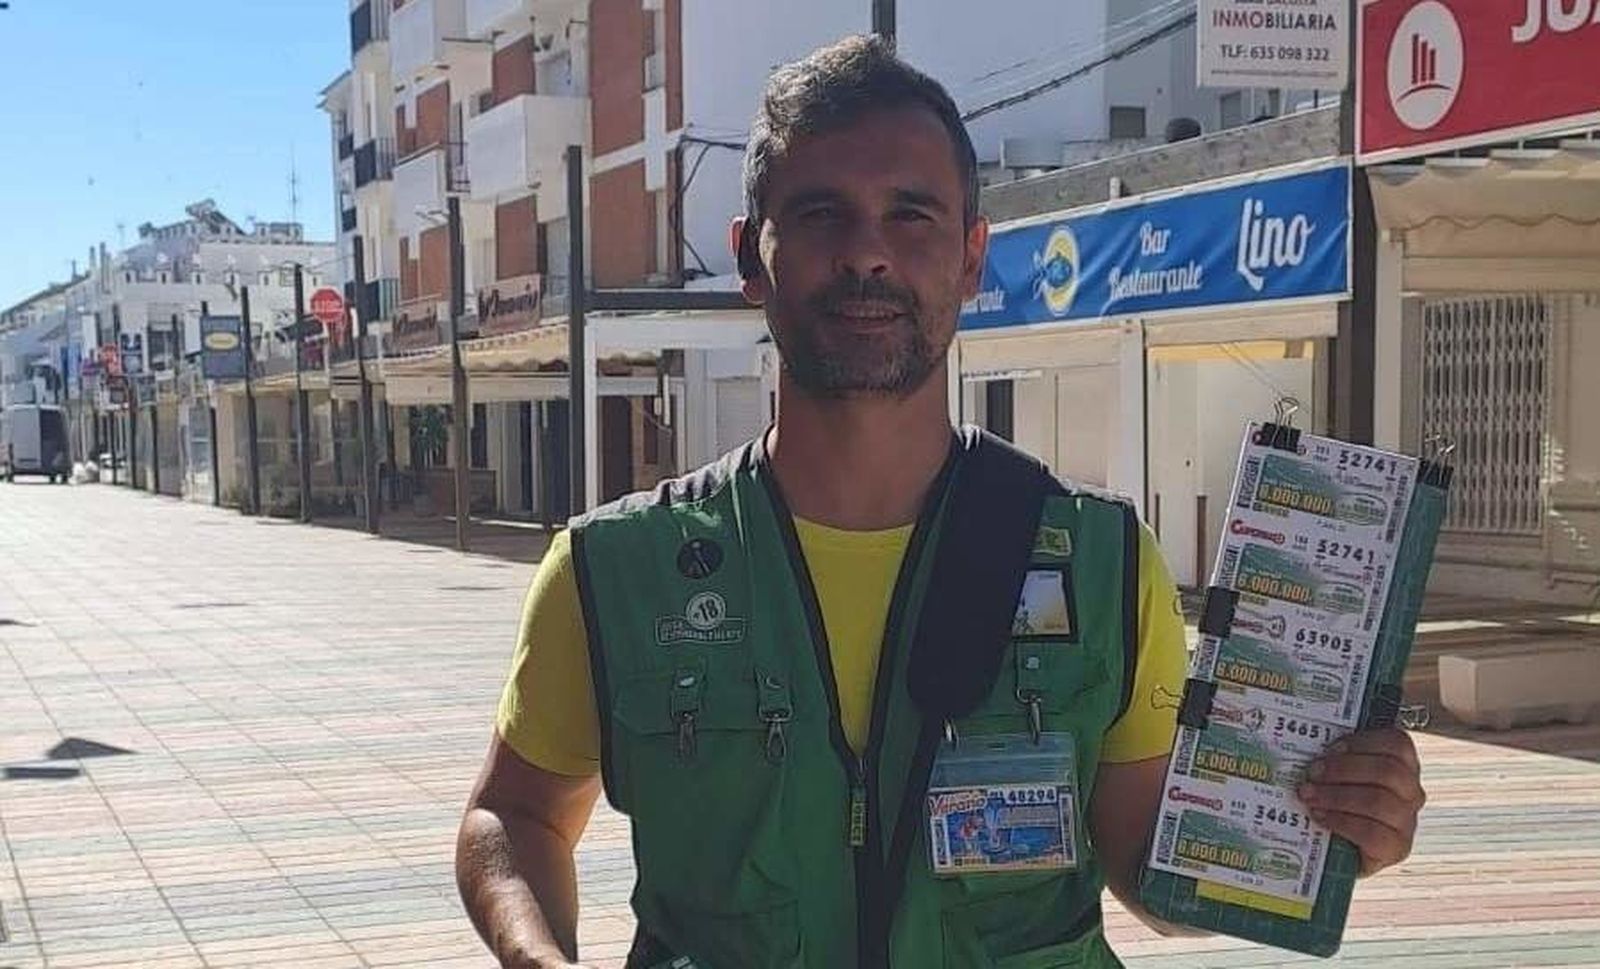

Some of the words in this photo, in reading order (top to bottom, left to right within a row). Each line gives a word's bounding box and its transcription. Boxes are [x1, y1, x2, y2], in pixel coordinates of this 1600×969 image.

[1212, 9, 1337, 31] INMOBILIARIA
[1250, 45, 1276, 60] 635
[1277, 47, 1302, 61] 098
[1304, 47, 1330, 62] 322
[1139, 220, 1172, 257] Bar
[1237, 199, 1316, 291] Lino
[1108, 264, 1204, 301] Restaurante
[1338, 449, 1399, 474] 52741
[1316, 538, 1376, 564] 52741
[1294, 627, 1354, 652] 63905
[1273, 716, 1332, 742] 34651
[1253, 805, 1311, 830] 34651
